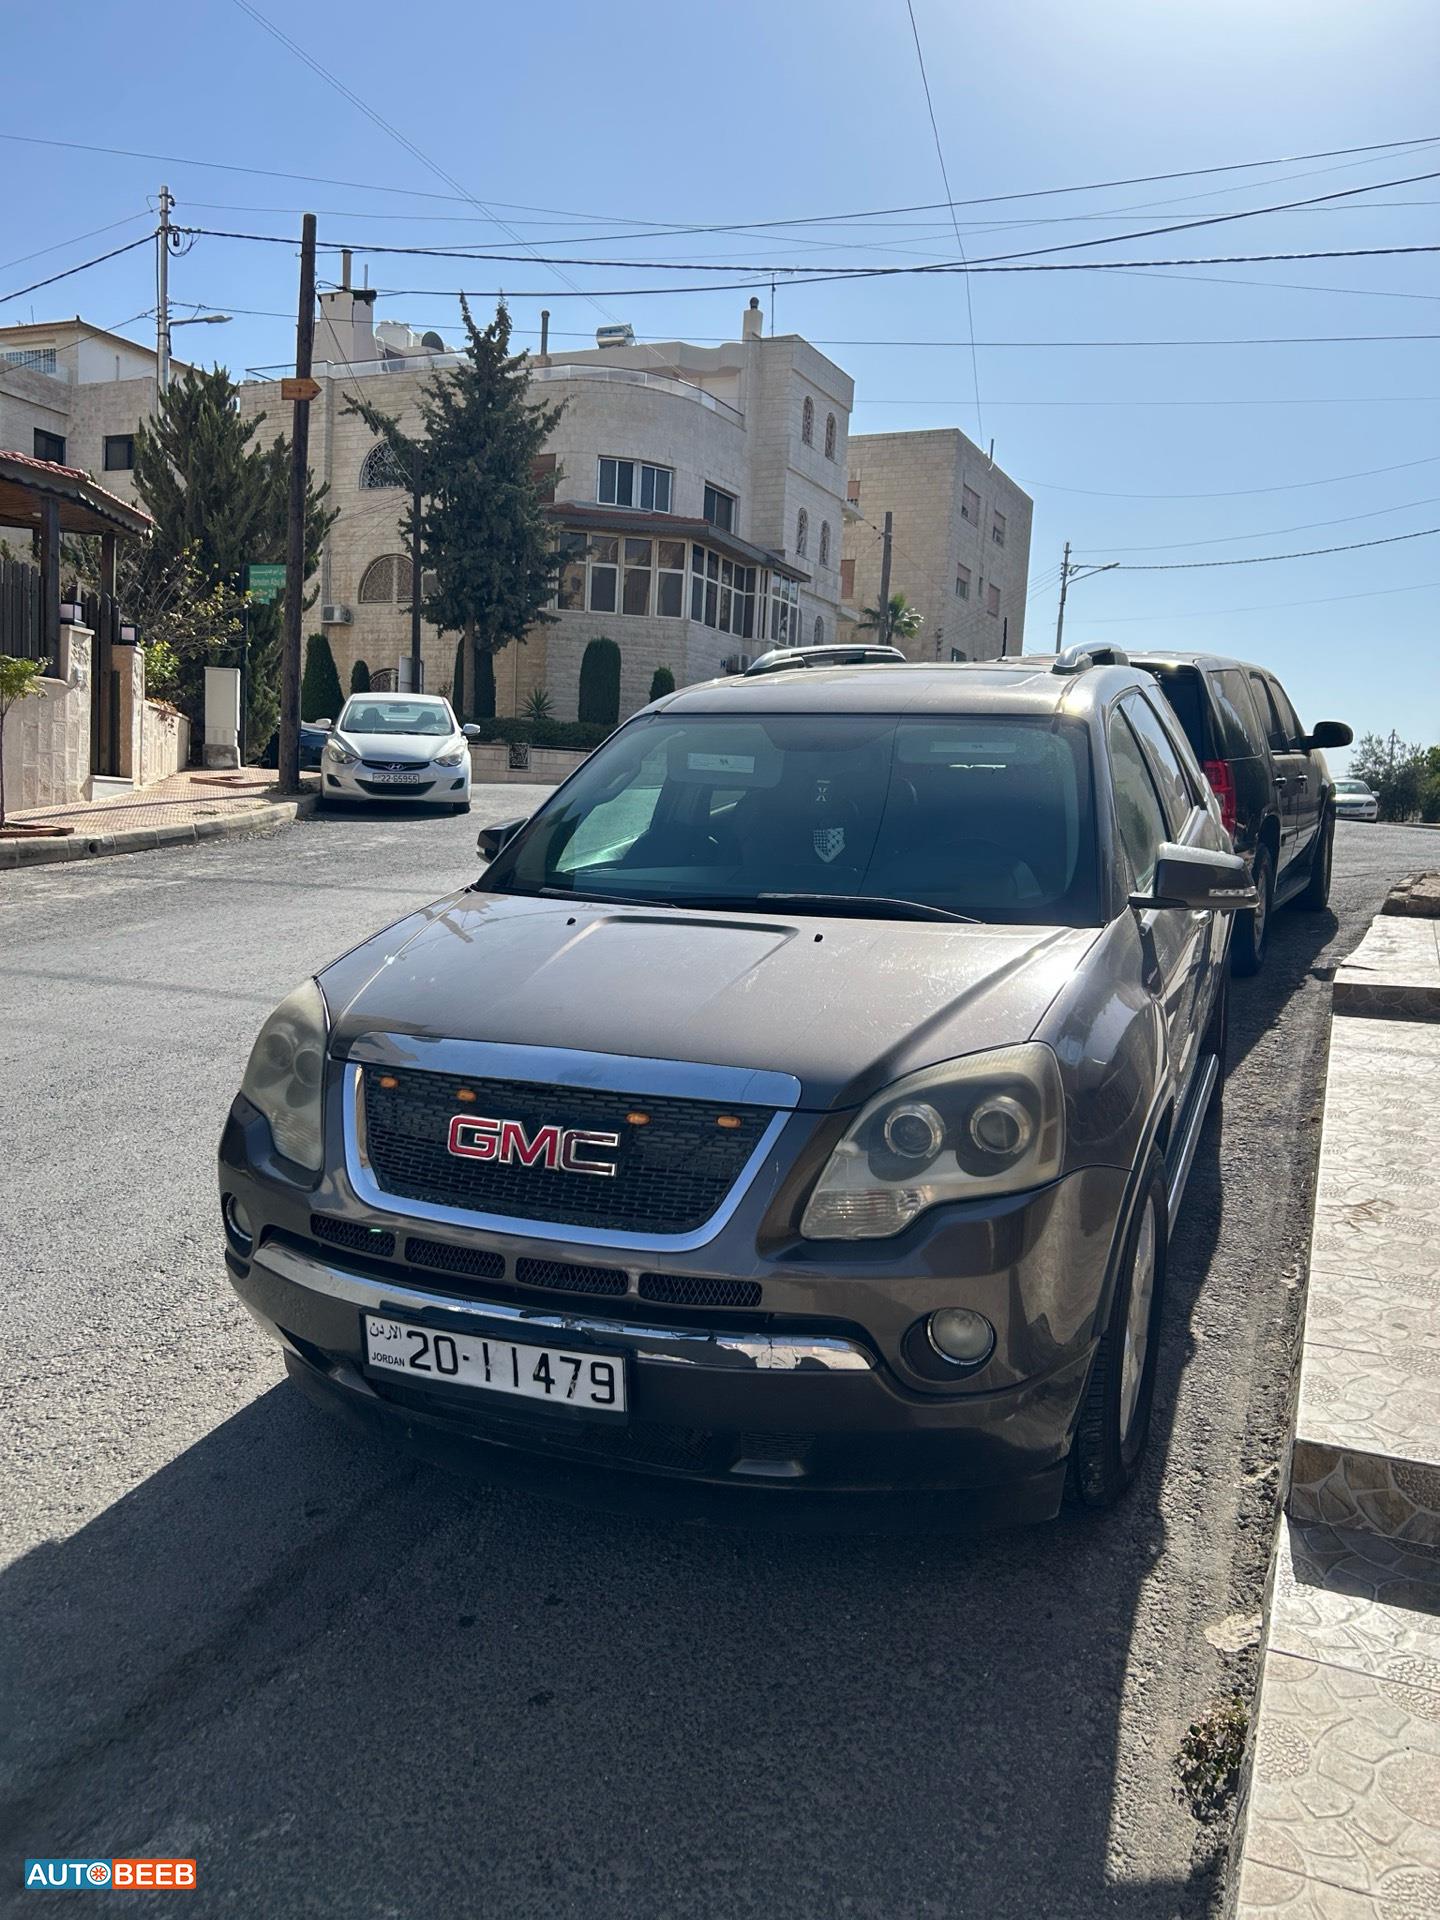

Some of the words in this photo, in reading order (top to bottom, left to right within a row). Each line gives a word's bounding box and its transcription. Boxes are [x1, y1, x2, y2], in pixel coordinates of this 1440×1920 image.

[447, 1114, 620, 1176] GMC
[372, 1352, 405, 1367] JORDAN
[406, 1331, 616, 1405] 20-11479
